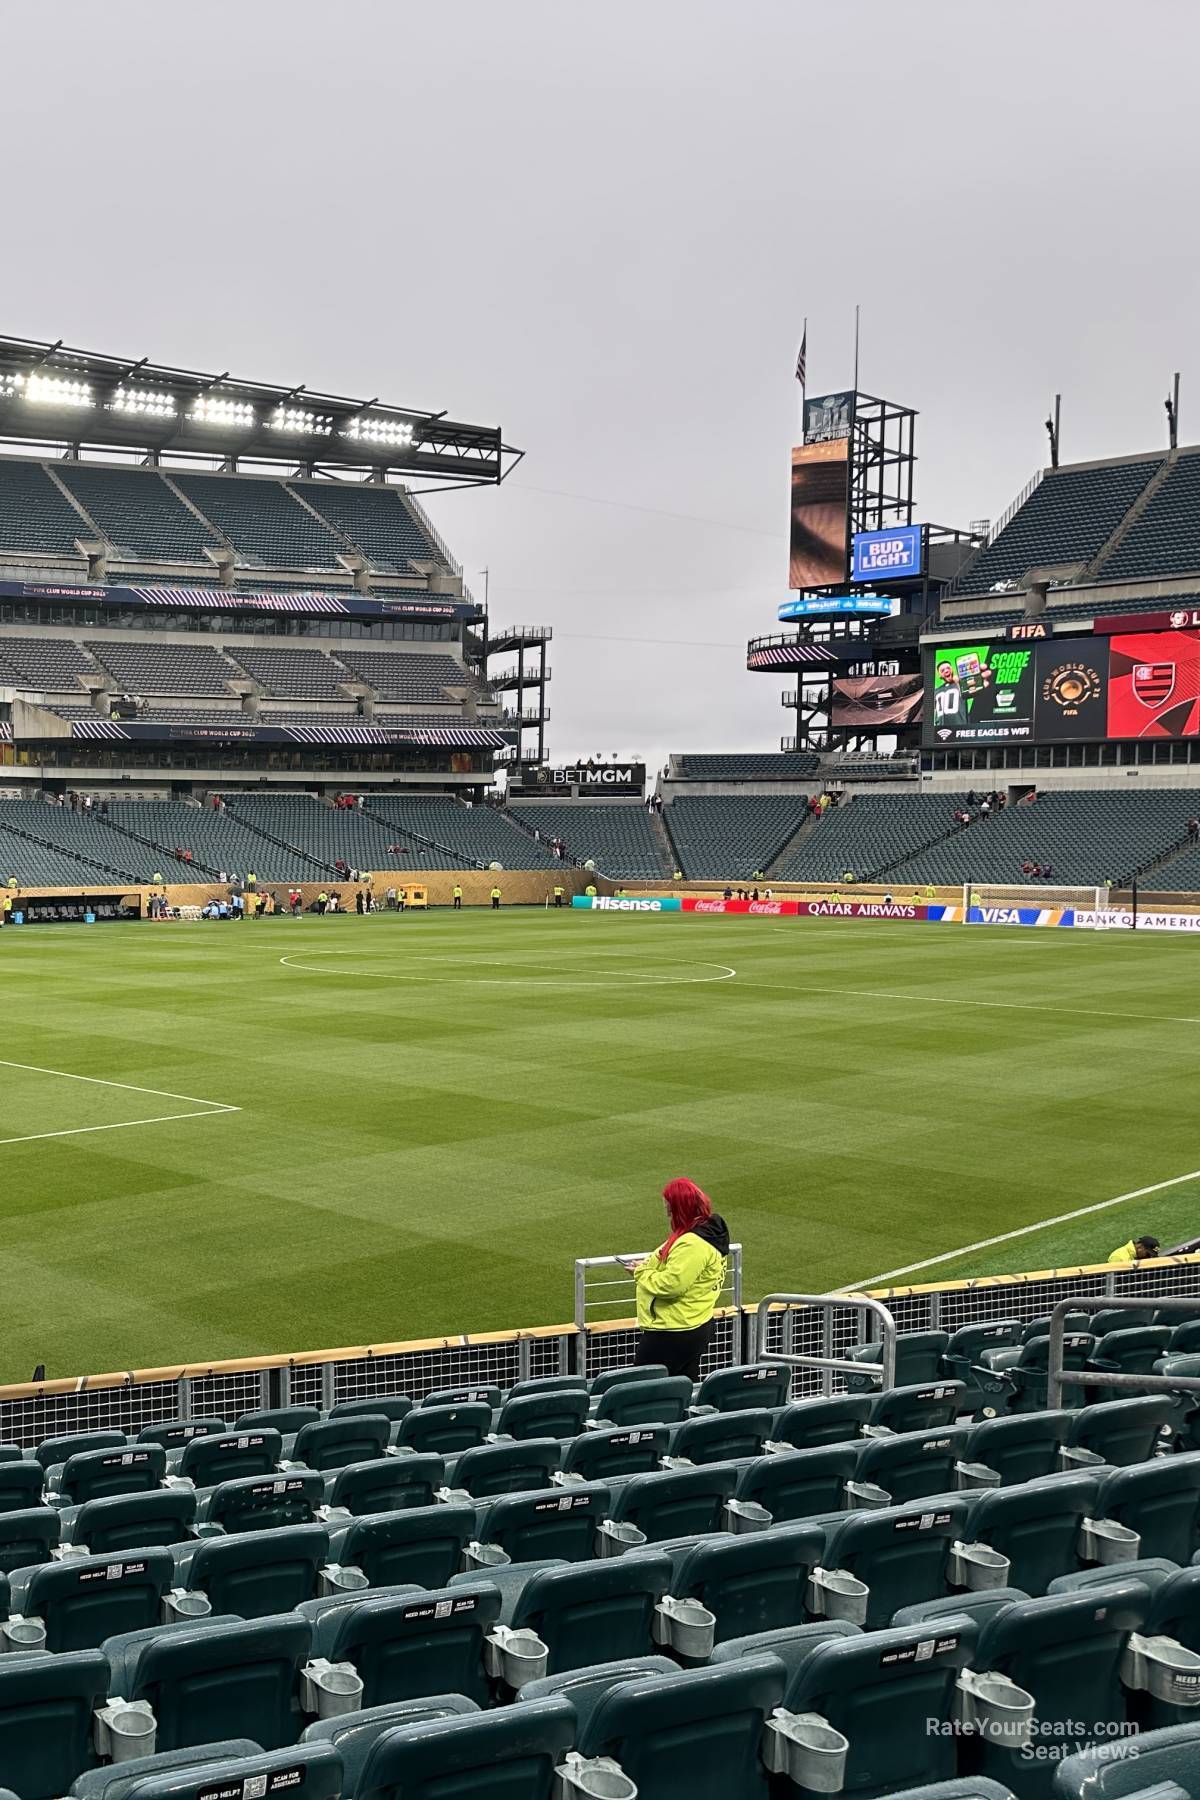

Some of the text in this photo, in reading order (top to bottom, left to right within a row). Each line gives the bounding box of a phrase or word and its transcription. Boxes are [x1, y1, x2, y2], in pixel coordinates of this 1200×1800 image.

[805, 428, 852, 444] CHAMPIONS
[870, 540, 904, 556] BUD
[862, 552, 910, 569] LIGHT
[1012, 624, 1046, 639] FIFA
[990, 651, 1032, 670] SCORE
[996, 667, 1023, 685] BIG!
[956, 727, 1030, 738] FREE EAGLES WIFI
[553, 770, 632, 784] BETMGM
[592, 896, 662, 911] Hisense
[695, 900, 727, 913] Coca-Cola
[749, 901, 780, 914] Coca-Cola
[808, 903, 916, 918] QATAR AIRWAYS
[979, 908, 1020, 924] VISA
[1077, 914, 1116, 924] BANK
[898, 1651, 915, 1659] HELP?
[1176, 1674, 1197, 1684] NEED
[271, 1777, 301, 1790] ASSISTANCE
[274, 1772, 300, 1784] SCAN FOR
[220, 1789, 241, 1799] HELP?
